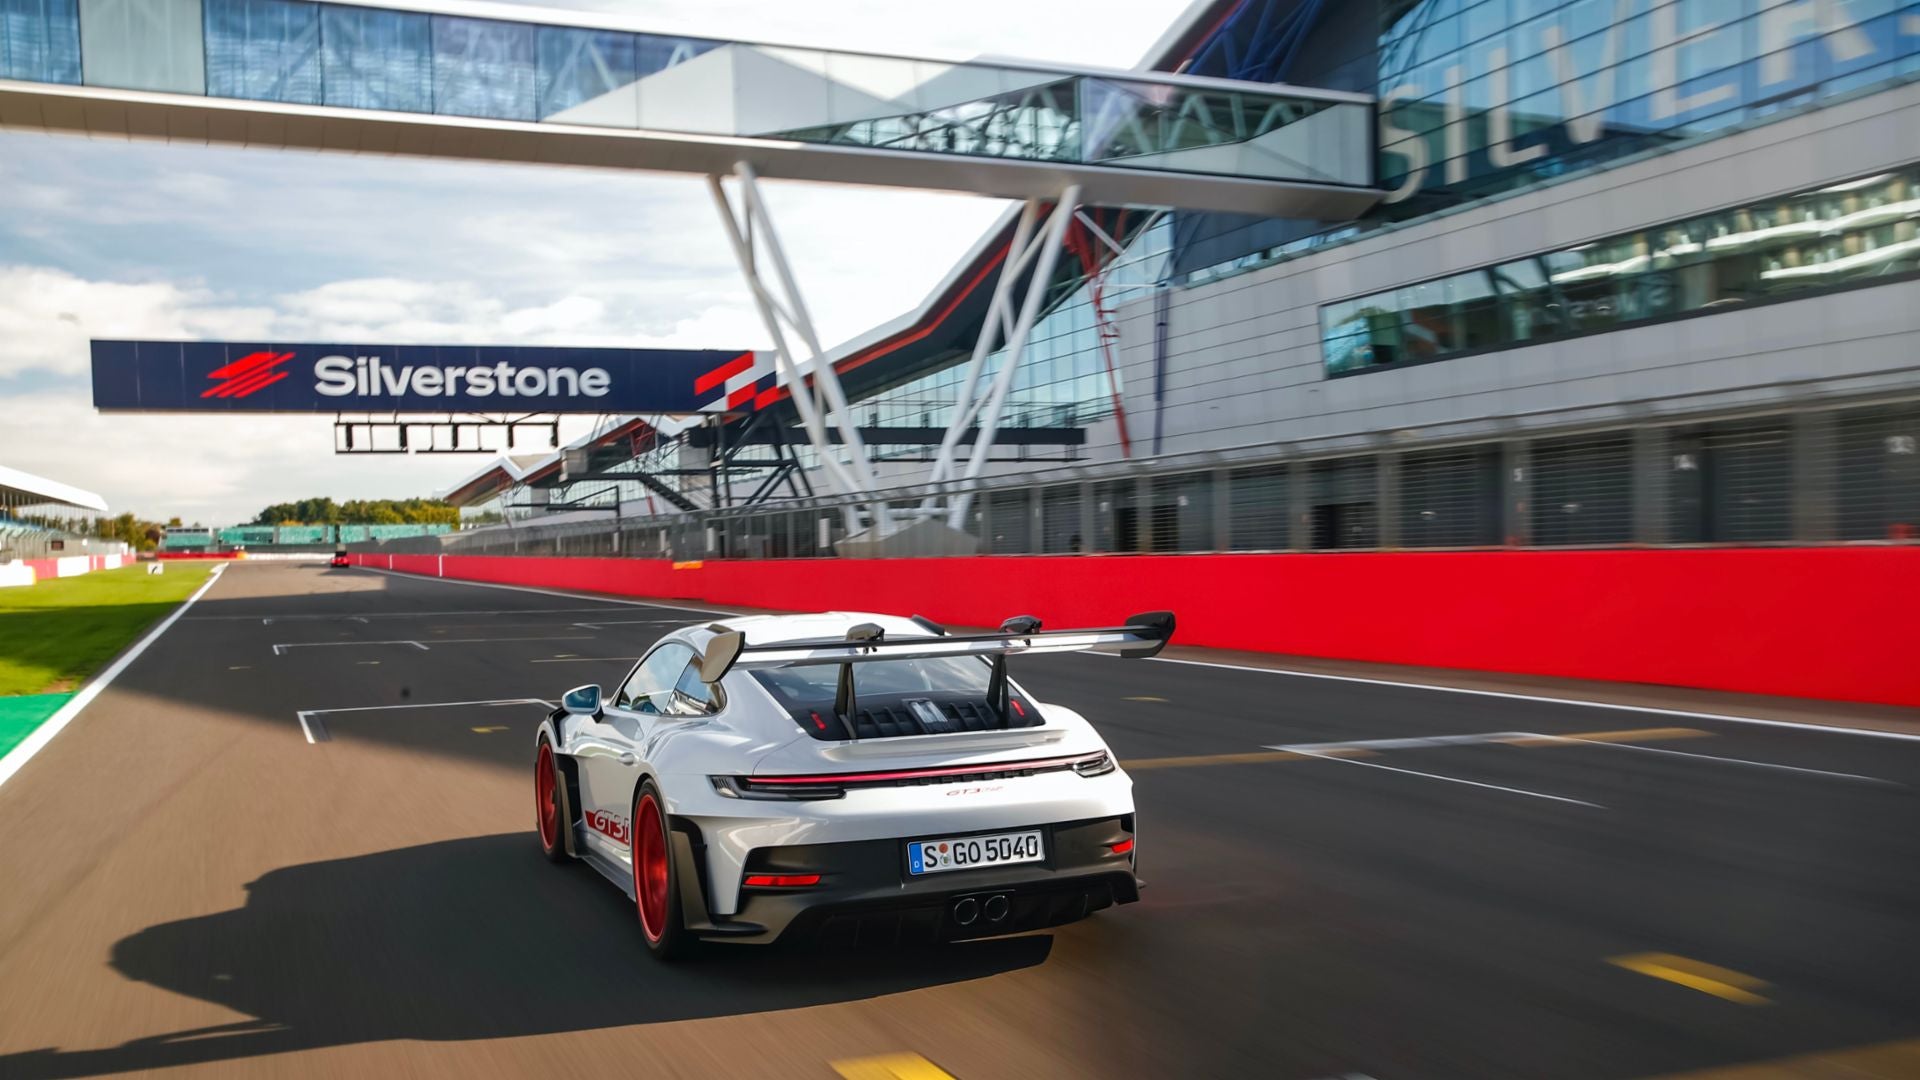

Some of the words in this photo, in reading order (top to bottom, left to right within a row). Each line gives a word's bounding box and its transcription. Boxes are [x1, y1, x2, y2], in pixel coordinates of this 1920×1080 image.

[313, 355, 611, 398] Silverstone
[923, 845, 938, 868] S
[952, 841, 982, 865] GO
[985, 835, 1039, 862] 5040
